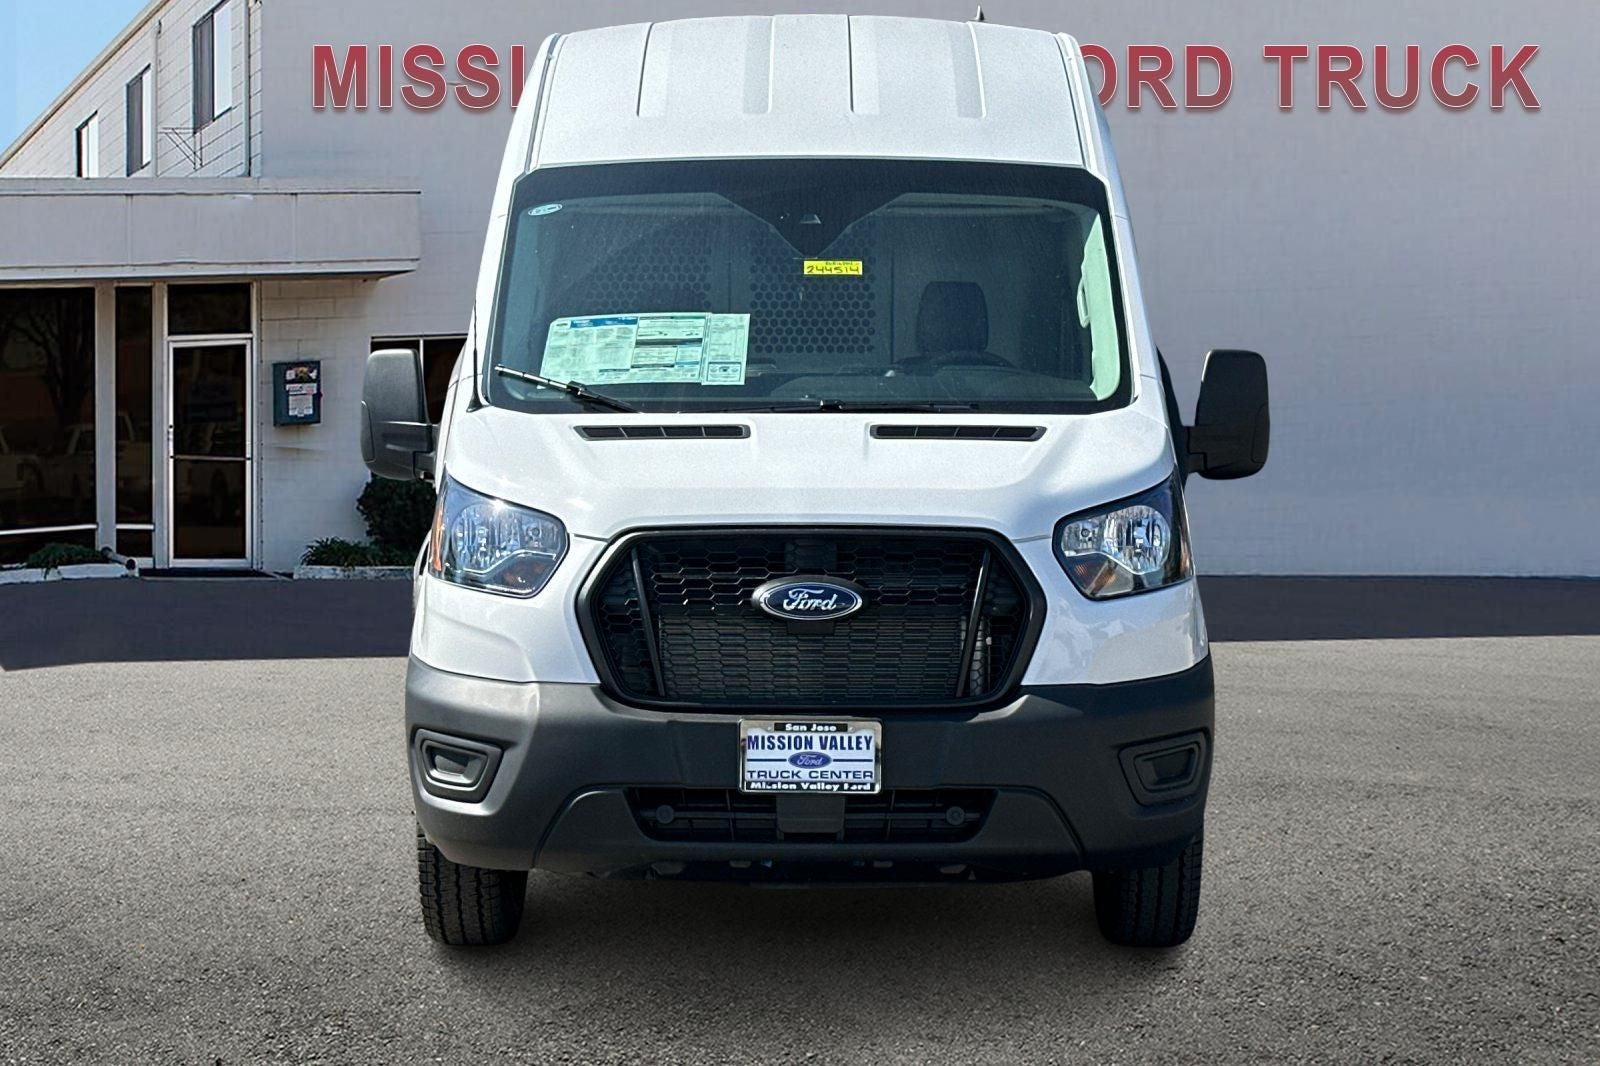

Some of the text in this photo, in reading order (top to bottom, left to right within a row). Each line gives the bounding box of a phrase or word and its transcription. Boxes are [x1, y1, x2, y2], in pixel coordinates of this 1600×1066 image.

[1263, 44, 1541, 108] TRUCK
[783, 588, 838, 610] Ford
[785, 723, 837, 731] San Jose
[747, 735, 873, 750] MISSION VALLEY
[796, 754, 823, 766] Ford
[747, 770, 873, 779] TRUCK CENTER
[750, 782, 797, 790] Mission
[801, 782, 840, 791] Valley
